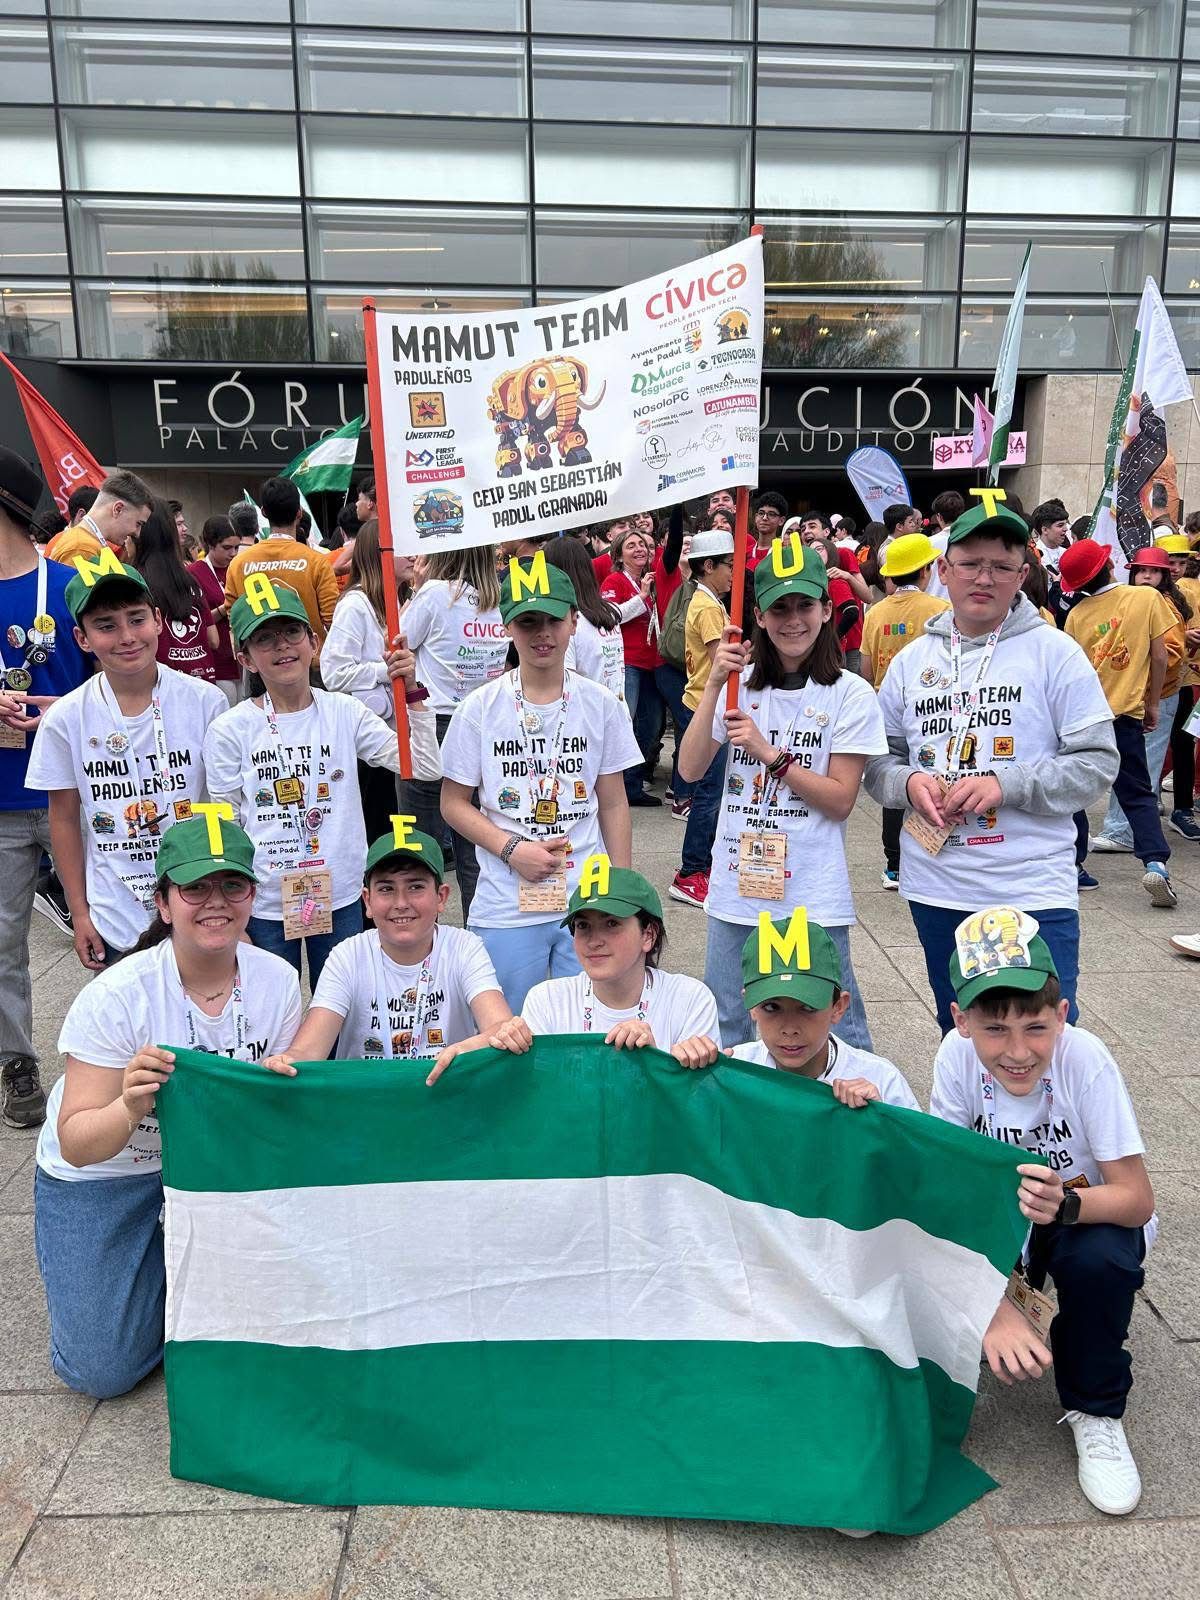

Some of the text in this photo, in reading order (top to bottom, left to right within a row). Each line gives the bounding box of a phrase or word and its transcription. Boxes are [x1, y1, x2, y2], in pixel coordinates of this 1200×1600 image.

[659, 315, 686, 329] PEOPLE
[687, 303, 716, 317] BEYOND
[718, 295, 738, 306] TECH
[391, 297, 629, 363] MAMUT TEAM
[630, 338, 683, 360] Ayuntamiento
[642, 346, 683, 367] de Padul
[710, 347, 757, 365] TECNOCASA
[393, 366, 473, 386] PADULEÑOS
[696, 379, 729, 394] LORENZO
[729, 377, 759, 386] PALMERO
[153, 370, 371, 429] FÓRU
[405, 429, 456, 441] UNEARTHED
[435, 446, 457, 455] FIRST
[435, 453, 455, 461] LEGO
[436, 457, 464, 467] LEAGUE
[410, 469, 461, 481] CHALLENGE
[472, 460, 623, 508] CEIP SAN SEBASTIÁN
[492, 489, 608, 529] PADUL (GRANADA)
[969, 487, 1008, 518] T
[72, 546, 128, 587] M
[771, 531, 805, 579] U
[243, 558, 308, 577] UNEARTHED
[508, 550, 551, 602] M
[244, 572, 280, 616] A
[83, 748, 192, 778] MAMU TAM
[251, 744, 331, 767] MAMT TEM
[727, 804, 809, 818] EIP SAN EBASTIÁN
[189, 802, 235, 856] T
[389, 815, 423, 851] E
[258, 838, 300, 847] Ayuntamiento
[267, 845, 300, 855] de Padul
[728, 845, 738, 854] de
[578, 853, 610, 899] A
[758, 905, 811, 974] M
